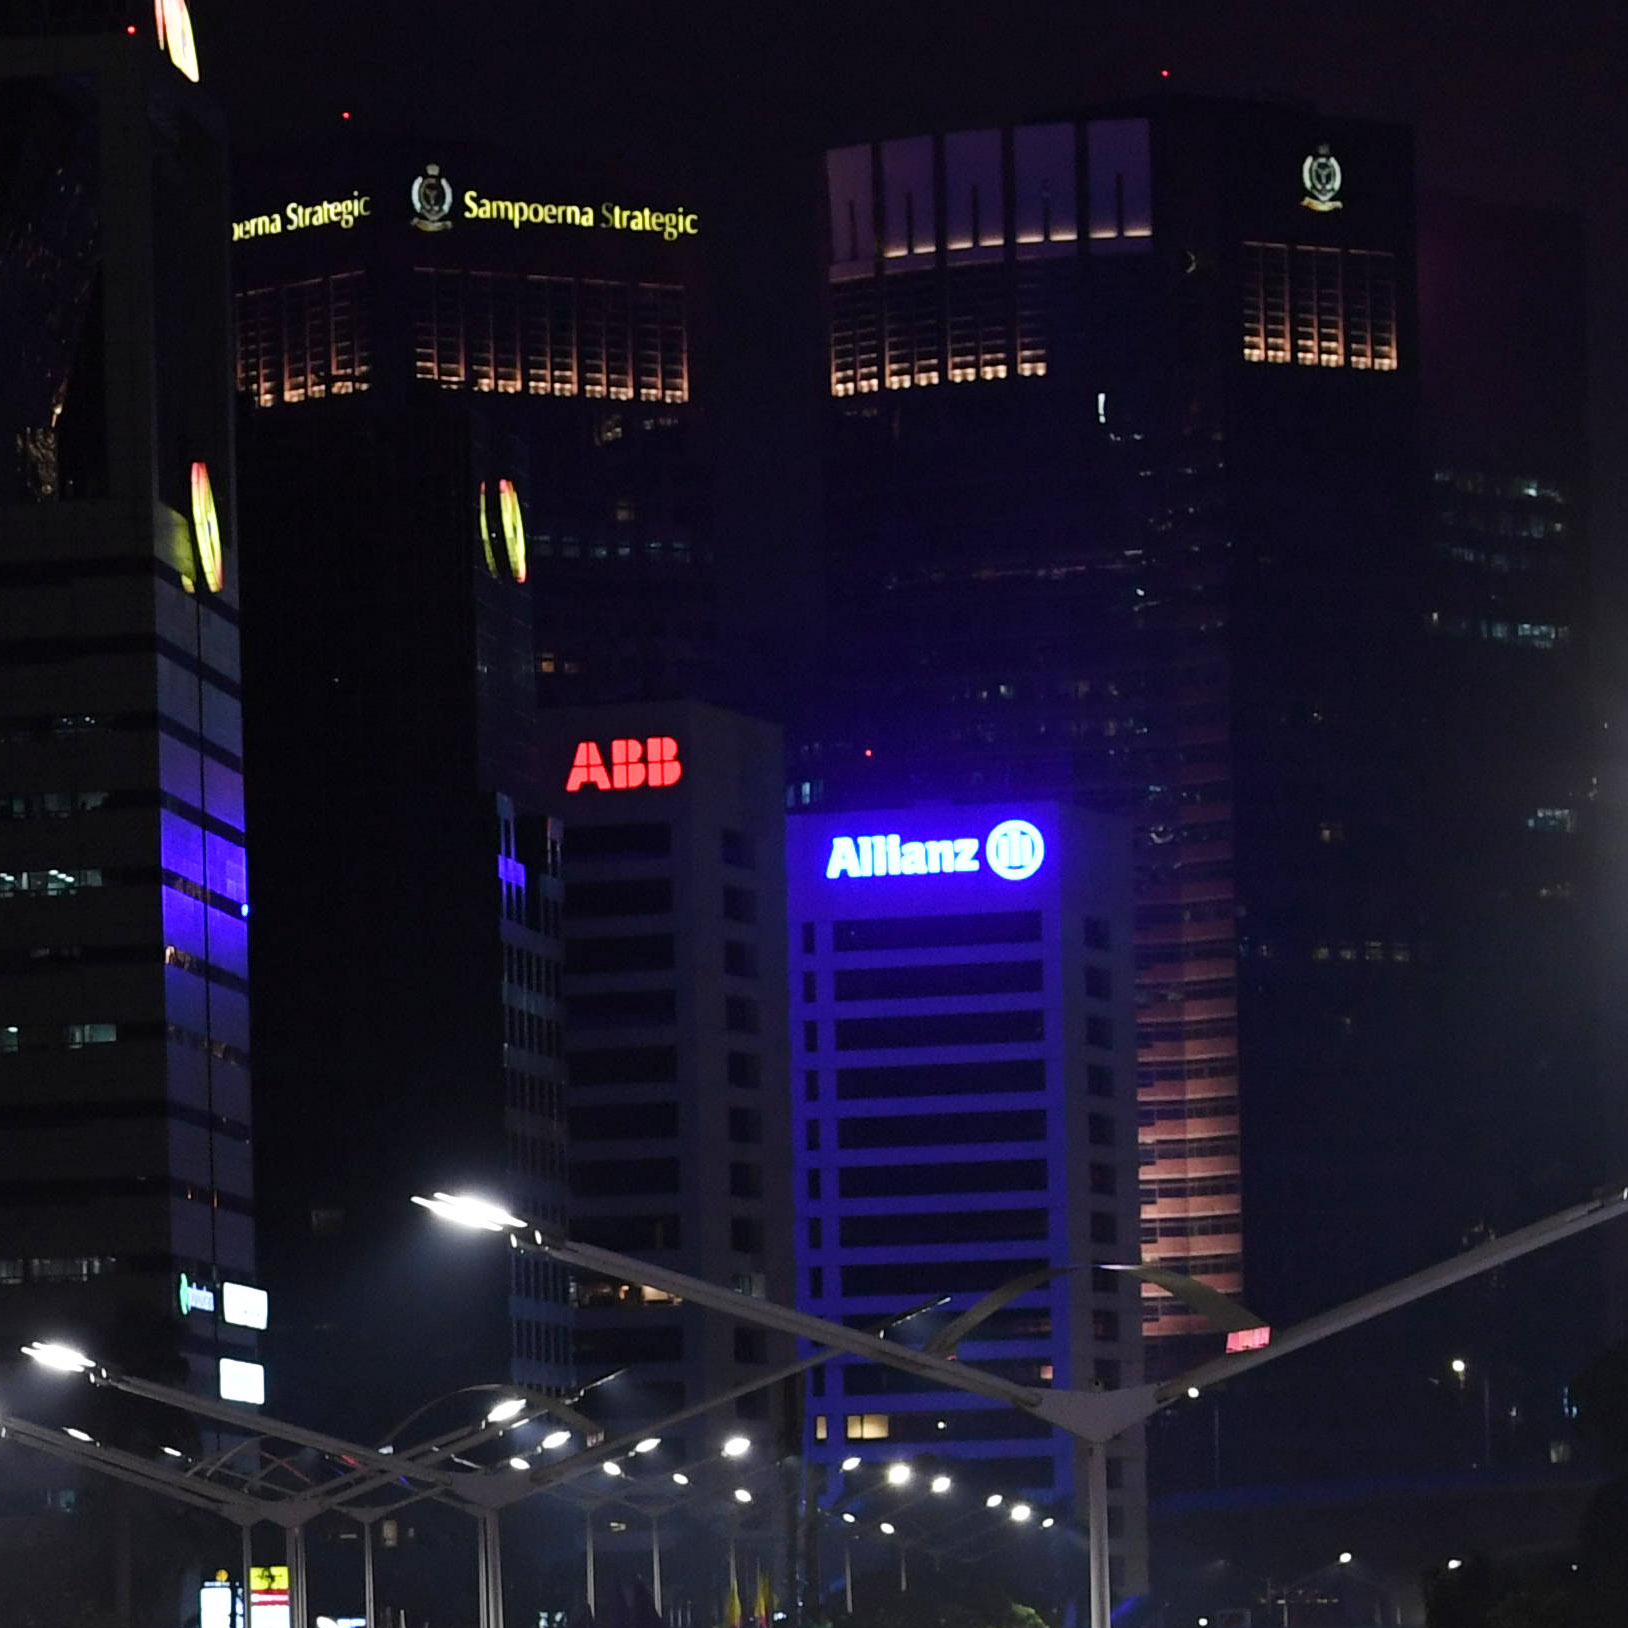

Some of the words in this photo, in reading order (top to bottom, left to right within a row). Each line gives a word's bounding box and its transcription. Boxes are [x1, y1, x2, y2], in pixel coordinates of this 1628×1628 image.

[285, 189, 373, 232] Strategic
[463, 189, 595, 230] Sampoerna
[599, 201, 700, 242] Strategic
[564, 735, 684, 793] ABB
[825, 833, 981, 880] Allianz
